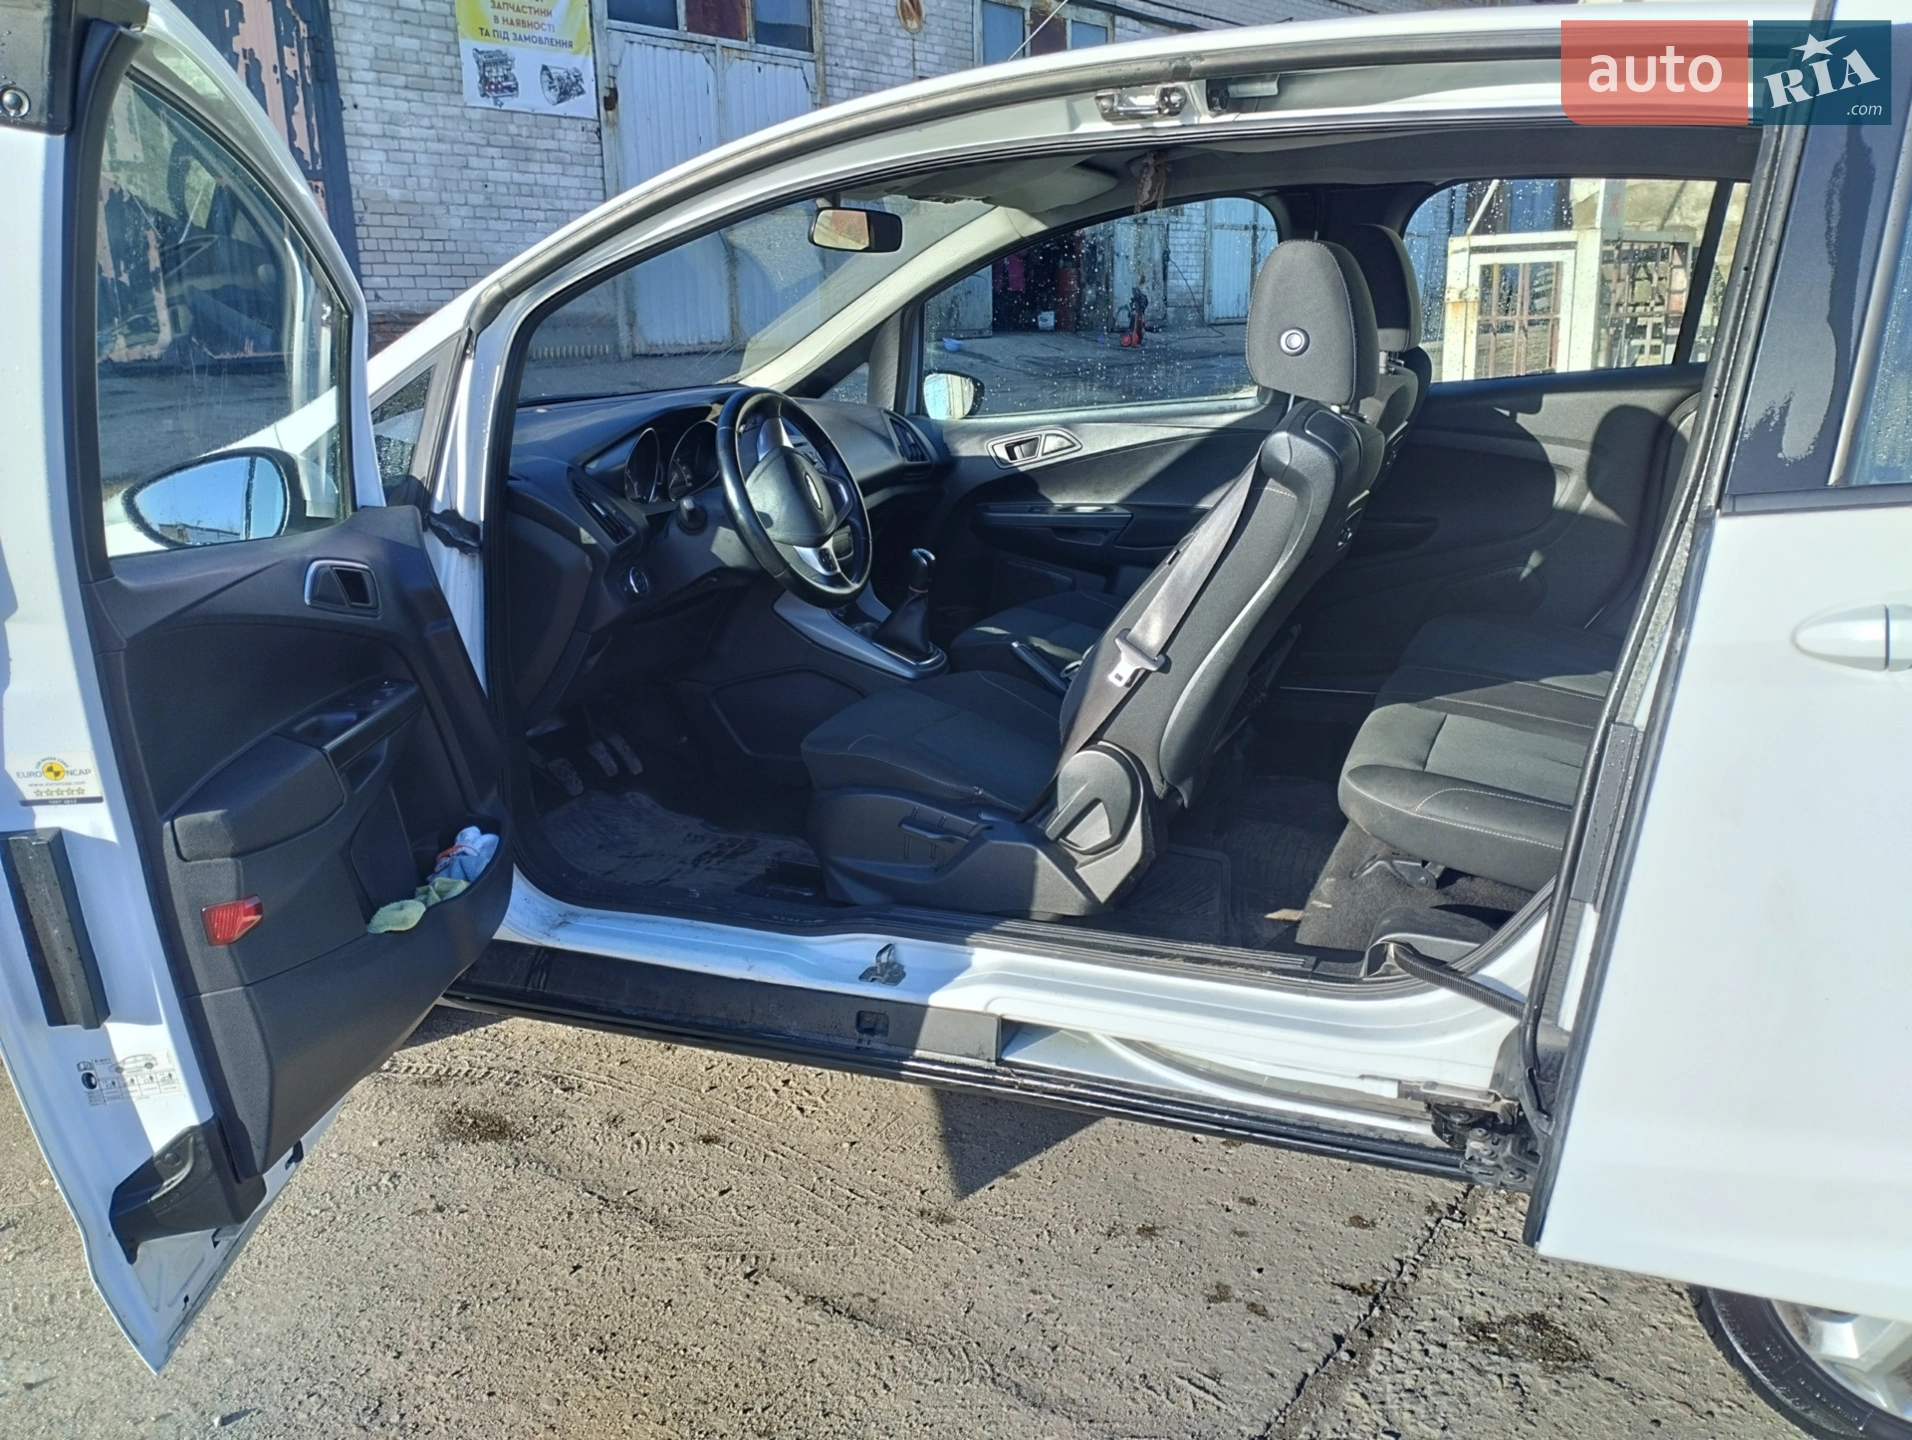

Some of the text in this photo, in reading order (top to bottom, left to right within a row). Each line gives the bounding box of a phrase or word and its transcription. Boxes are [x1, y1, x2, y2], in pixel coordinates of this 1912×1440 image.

[490, 0, 553, 18] ЗАПЧАСТИНИ
[493, 15, 555, 33] В НАЯВНОСТІ
[478, 27, 573, 49] ТА ПІД ЗАМОВЛЕННЯ
[16, 768, 92, 779] EURO NCAP
